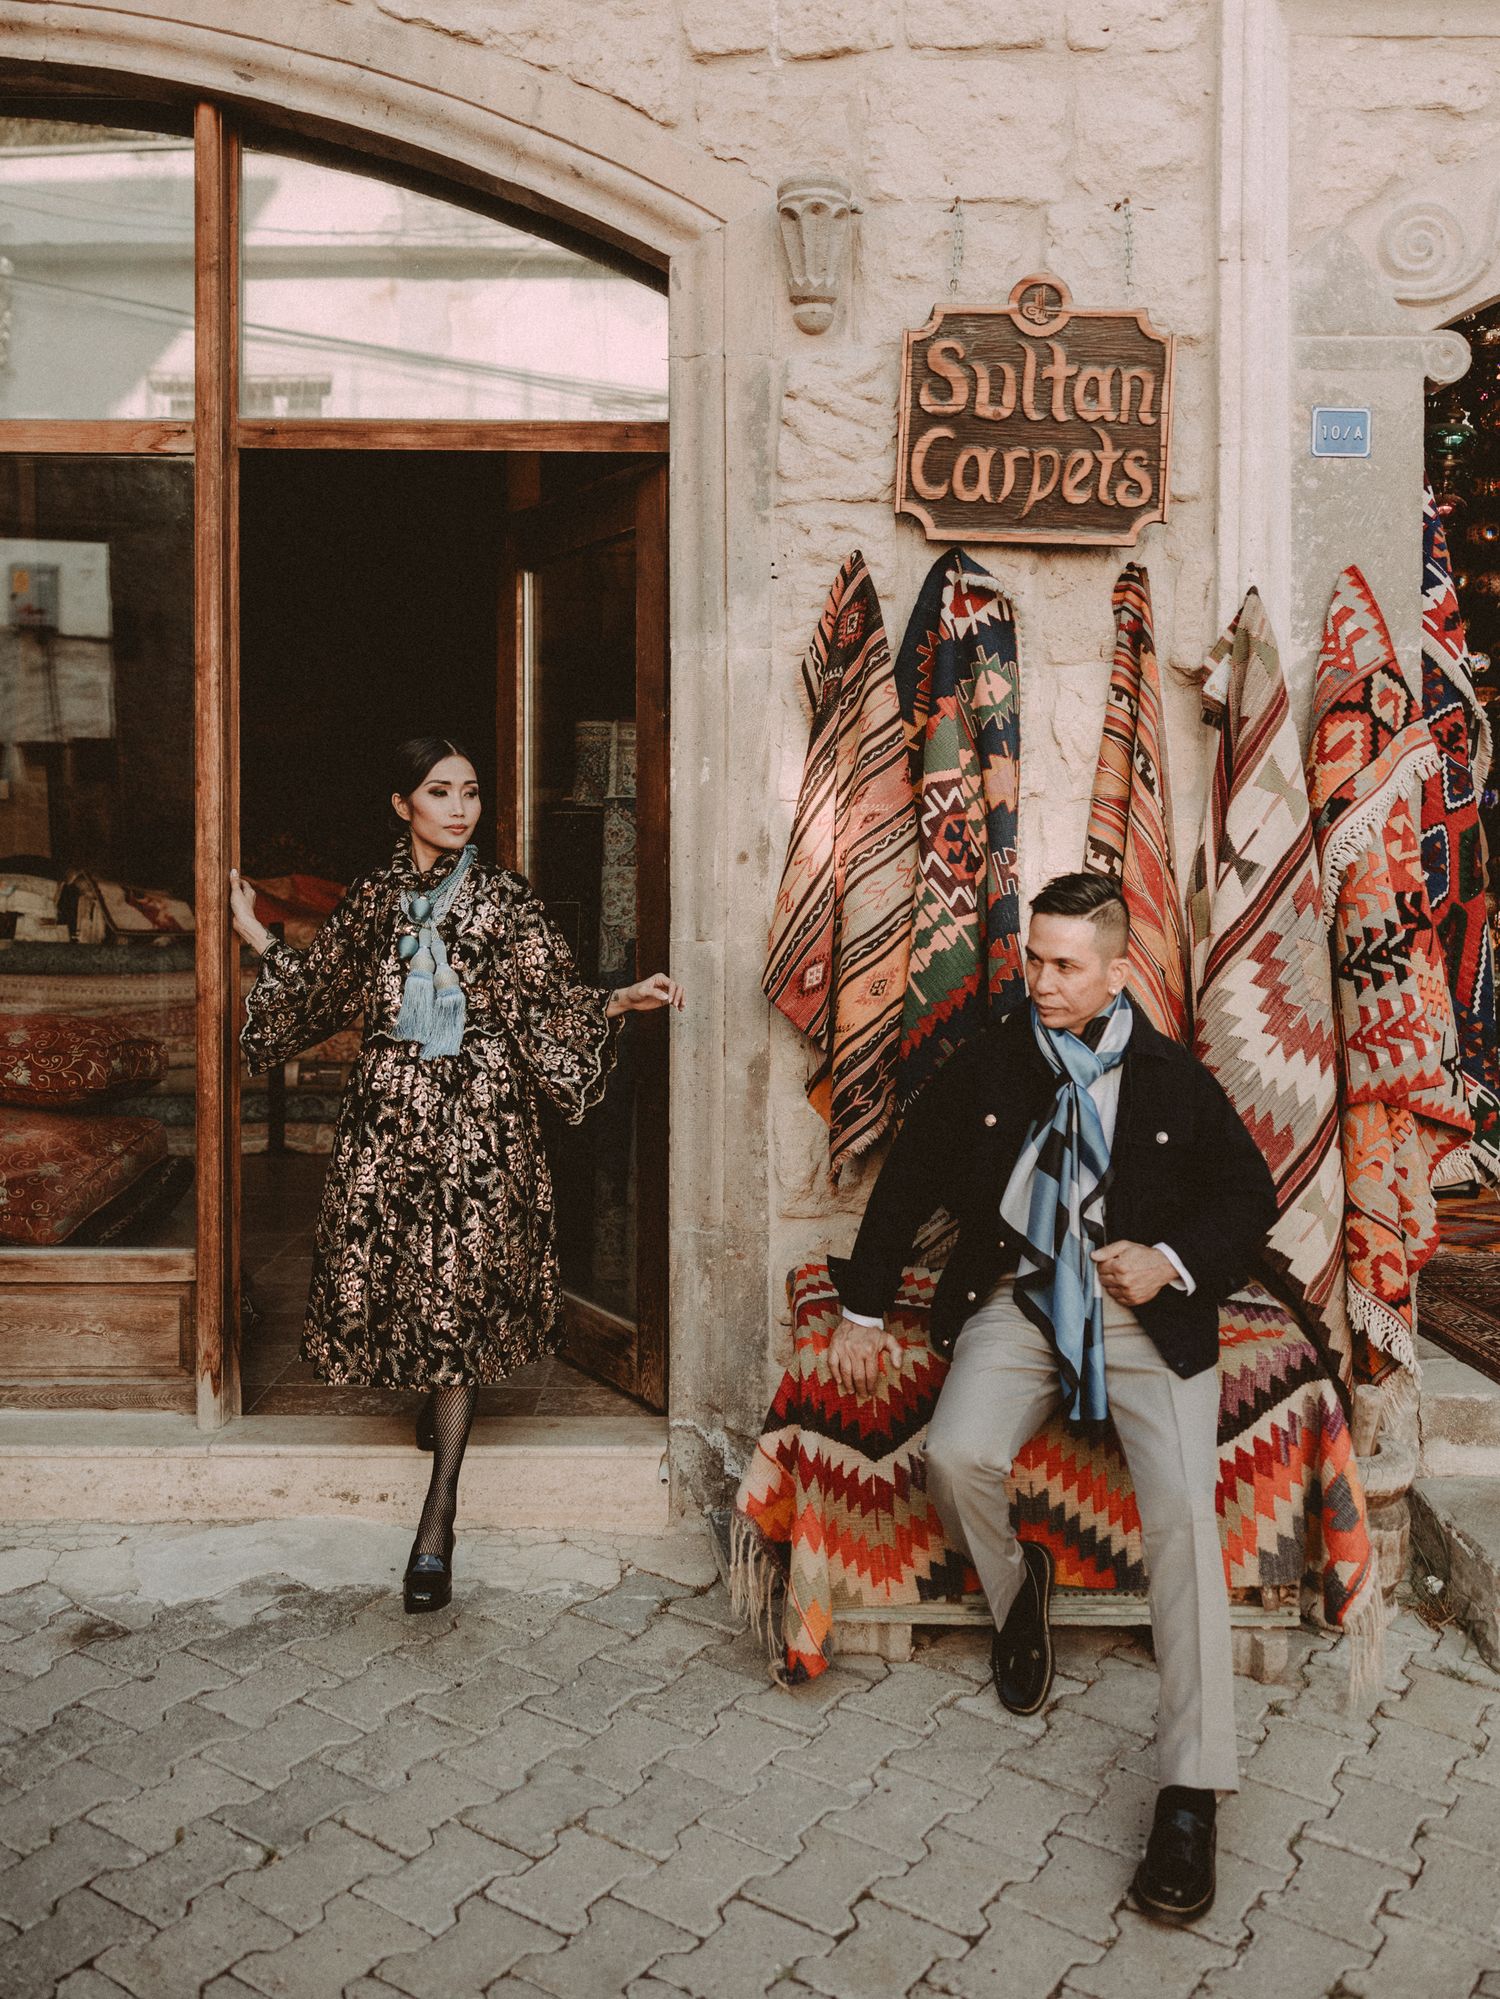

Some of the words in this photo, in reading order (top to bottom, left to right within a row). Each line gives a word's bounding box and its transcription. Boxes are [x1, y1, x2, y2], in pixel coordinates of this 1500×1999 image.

[919, 339, 1157, 425] Sultan
[911, 427, 1153, 519] Carpets
[1321, 425, 1364, 440] 10/A
